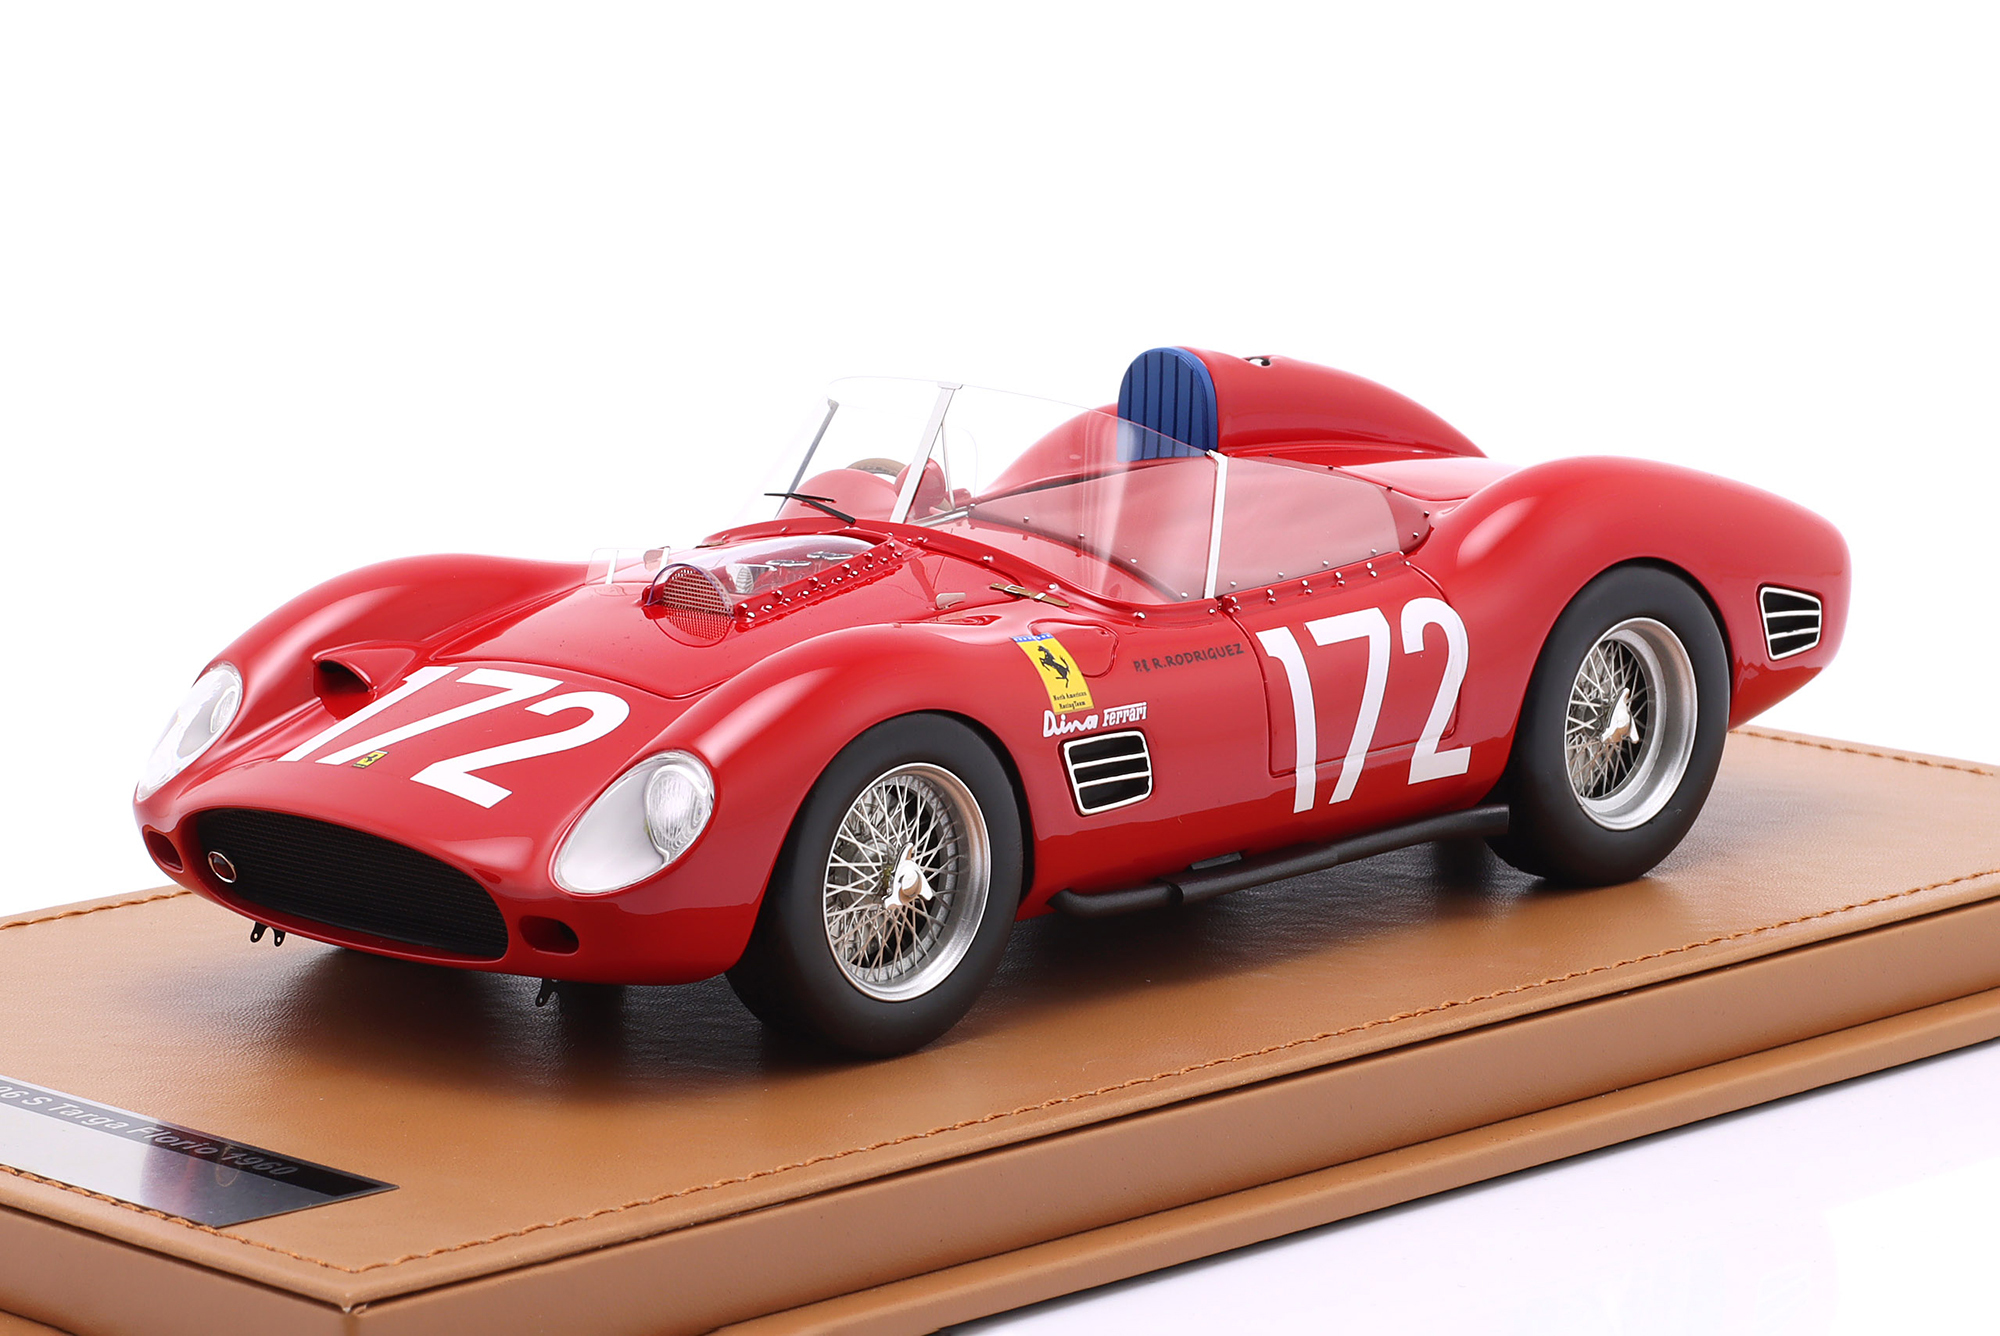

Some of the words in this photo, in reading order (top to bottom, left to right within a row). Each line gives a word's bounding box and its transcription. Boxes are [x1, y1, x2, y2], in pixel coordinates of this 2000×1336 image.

[277, 665, 631, 809] 172
[1102, 701, 1147, 727] Ferrari
[1255, 597, 1472, 814] 172
[21, 1096, 53, 1106] S
[48, 1102, 129, 1130] Targa
[126, 1126, 218, 1155] Florio
[222, 1152, 299, 1175] 1960
